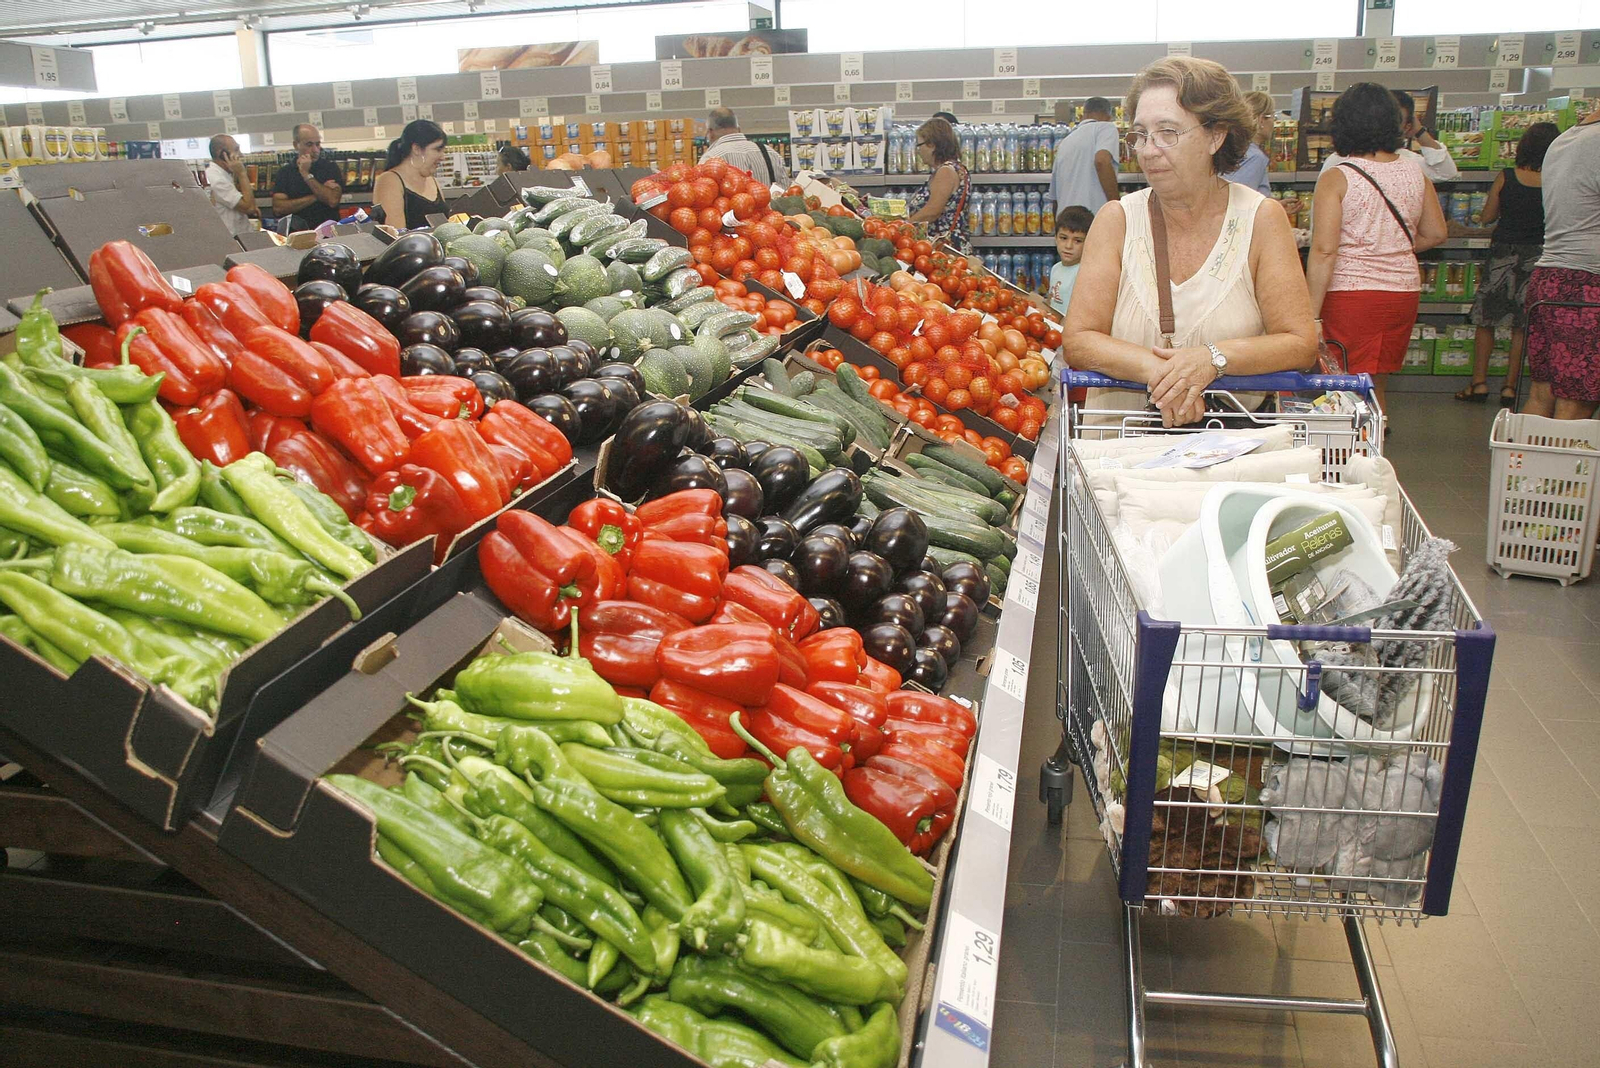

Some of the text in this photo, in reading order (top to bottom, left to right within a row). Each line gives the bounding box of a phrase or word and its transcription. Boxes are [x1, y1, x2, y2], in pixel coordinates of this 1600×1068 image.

[1379, 55, 1396, 65] 1,89
[1437, 55, 1456, 65] 1,79
[1501, 53, 1520, 64] 1,29
[1556, 50, 1576, 60] 2,99
[1315, 57, 1333, 66] 2,49
[999, 65, 1016, 75] 0,99
[40, 72, 57, 82] 1,95
[485, 87, 500, 96] 2,79
[402, 93, 416, 101] 1,99
[1303, 519, 1338, 540] Aceitunas
[1300, 526, 1343, 553] Rellenas
[1315, 542, 1334, 556] ANCHOA
[1011, 657, 1026, 677] 1,05
[997, 768, 1014, 794] 1,79
[972, 930, 997, 966] 1,29
